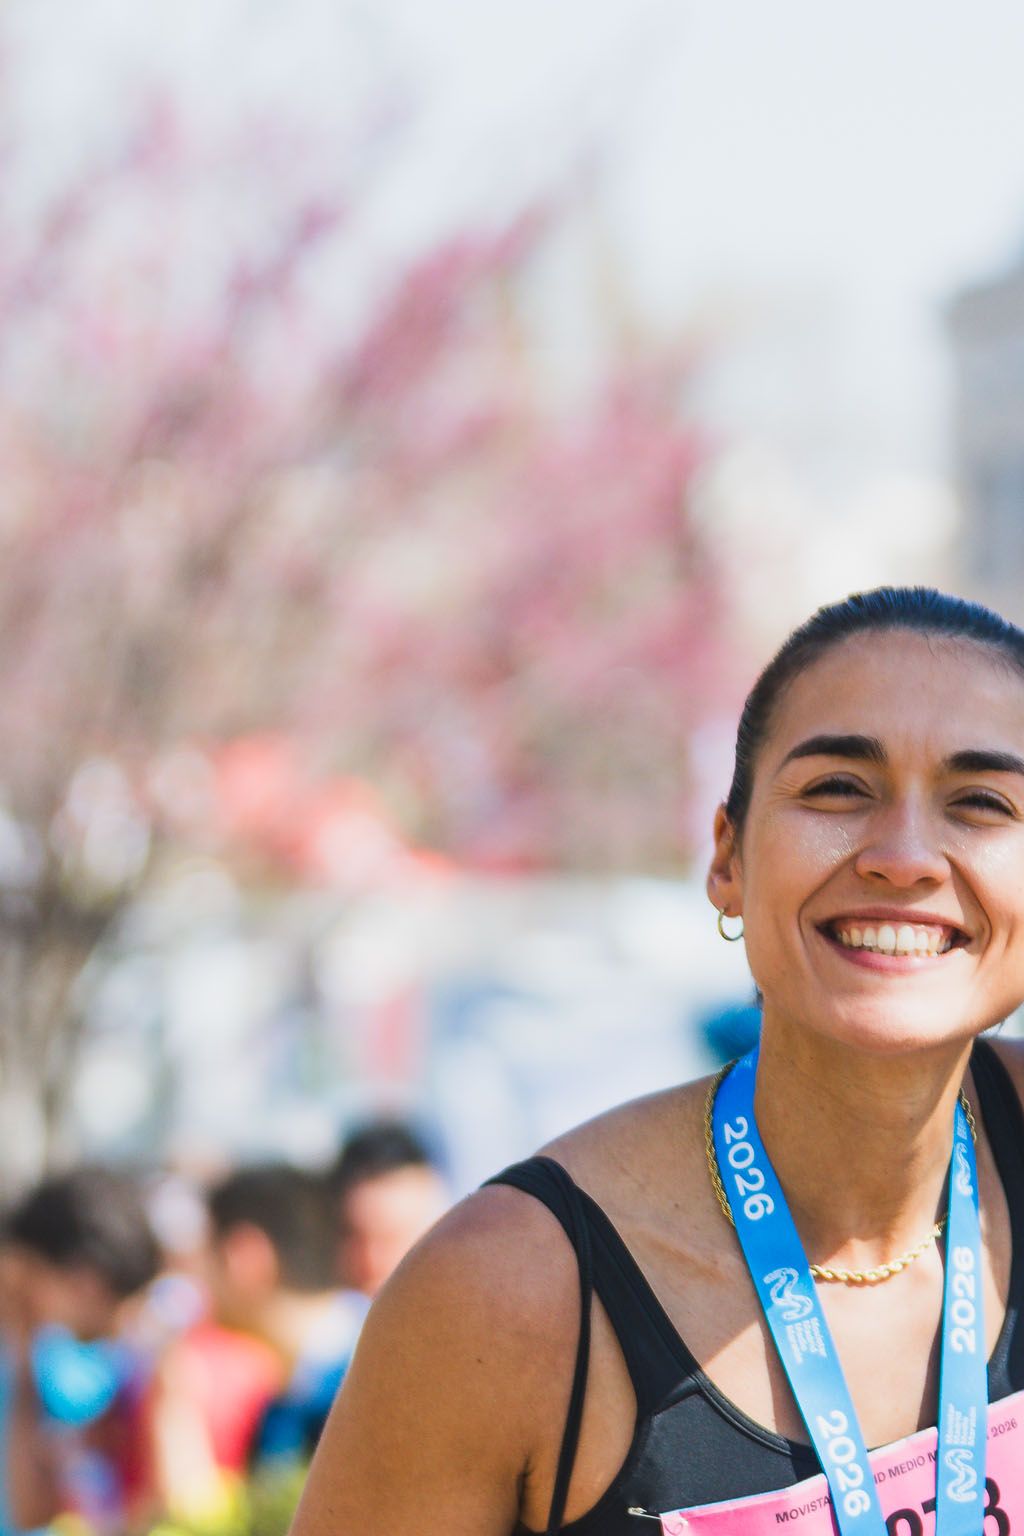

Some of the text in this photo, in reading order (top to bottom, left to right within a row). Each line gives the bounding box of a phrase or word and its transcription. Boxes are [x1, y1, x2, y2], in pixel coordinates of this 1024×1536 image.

[724, 1116, 775, 1222] 2026
[775, 1494, 831, 1524] MOVISTA
[888, 1454, 931, 1478] MEDIO
[990, 1417, 1018, 1438] 2026
[815, 1408, 872, 1518] 2026
